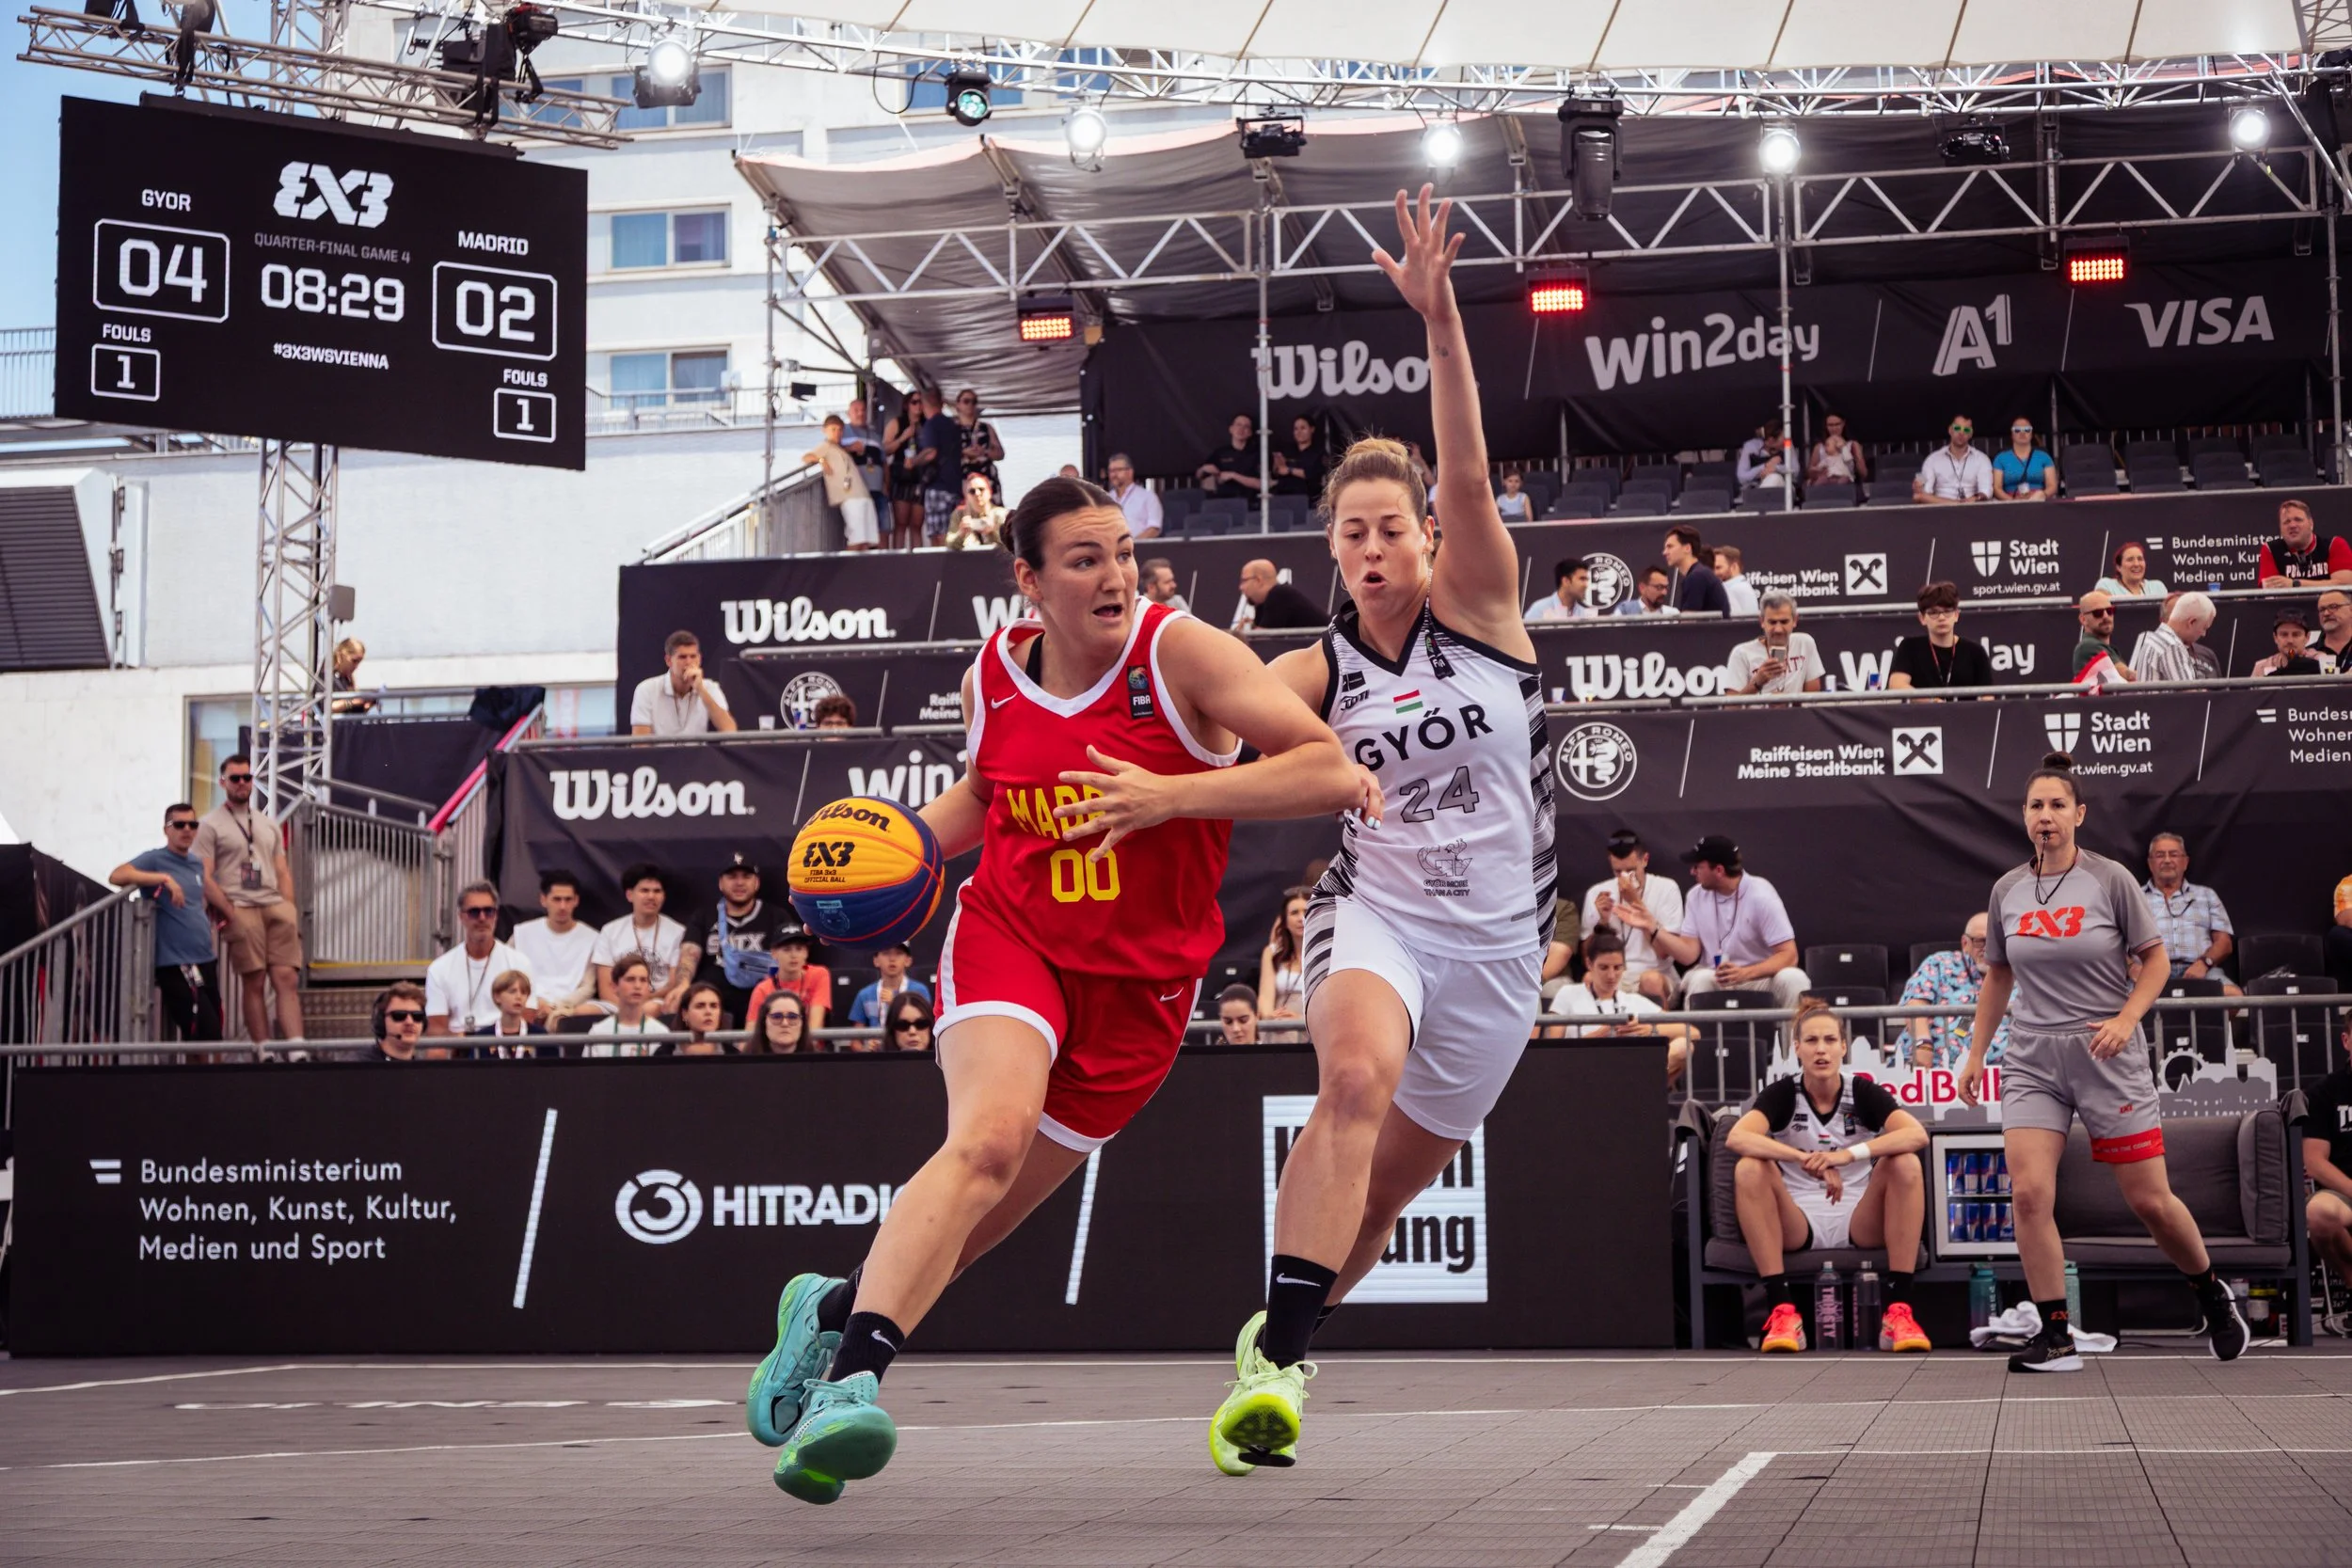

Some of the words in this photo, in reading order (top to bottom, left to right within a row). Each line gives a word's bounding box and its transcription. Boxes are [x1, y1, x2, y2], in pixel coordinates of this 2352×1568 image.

[141, 189, 191, 212] GYOR
[255, 232, 358, 258] QUARTER-FINAL
[361, 245, 398, 262] GAME
[402, 250, 411, 264] 4
[458, 230, 529, 256] MADRID
[119, 239, 207, 303] 04
[261, 263, 405, 322] 08:29
[456, 281, 535, 341] 02
[2124, 296, 2275, 348] VISA
[103, 324, 151, 342] FOULS
[1933, 293, 2012, 376] A1
[274, 342, 389, 370] #3X3WSVIENNA
[1250, 340, 1431, 400] Wilso
[117, 356, 135, 389] 1
[503, 369, 548, 388] FOULS
[516, 398, 534, 432] 1
[2010, 538, 2059, 557] Stadt
[2172, 552, 2233, 566] Wohnen,
[1746, 571, 1797, 585] iffeisen
[1800, 569, 1839, 583] Wien
[2010, 558, 2059, 576] Wien
[2173, 569, 2224, 583] Medien
[2230, 567, 2255, 581] und
[1973, 581, 2060, 597] sport.wien.gv.at
[721, 596, 889, 644] Wilson
[1133, 695, 1151, 705] FIBA
[919, 708, 961, 721] Meine
[2091, 710, 2151, 732] Stadt
[1354, 705, 1493, 771] GYŐR
[1561, 730, 1587, 763] ALFA
[1591, 726, 1632, 762] ROMEO
[2091, 734, 2152, 753] Wien
[1750, 745, 1834, 763] Raiffeisen
[1838, 743, 1884, 760] Wien
[2290, 748, 2351, 763] Medien
[1738, 763, 1790, 779] Meine
[1795, 759, 1885, 778] Stadtbank
[549, 766, 747, 820] Wilson
[1399, 766, 1480, 824] 24
[1050, 847, 1120, 902] 00
[1931, 1068, 2002, 1103] Bll
[141, 1157, 402, 1184] Bundesministerium
[139, 1196, 257, 1225] Wohnen,
[269, 1196, 355, 1225] Kunst,
[367, 1194, 456, 1223] Kultur,
[139, 1234, 238, 1260] Medien
[250, 1233, 299, 1260] und
[311, 1233, 386, 1265] Sport
